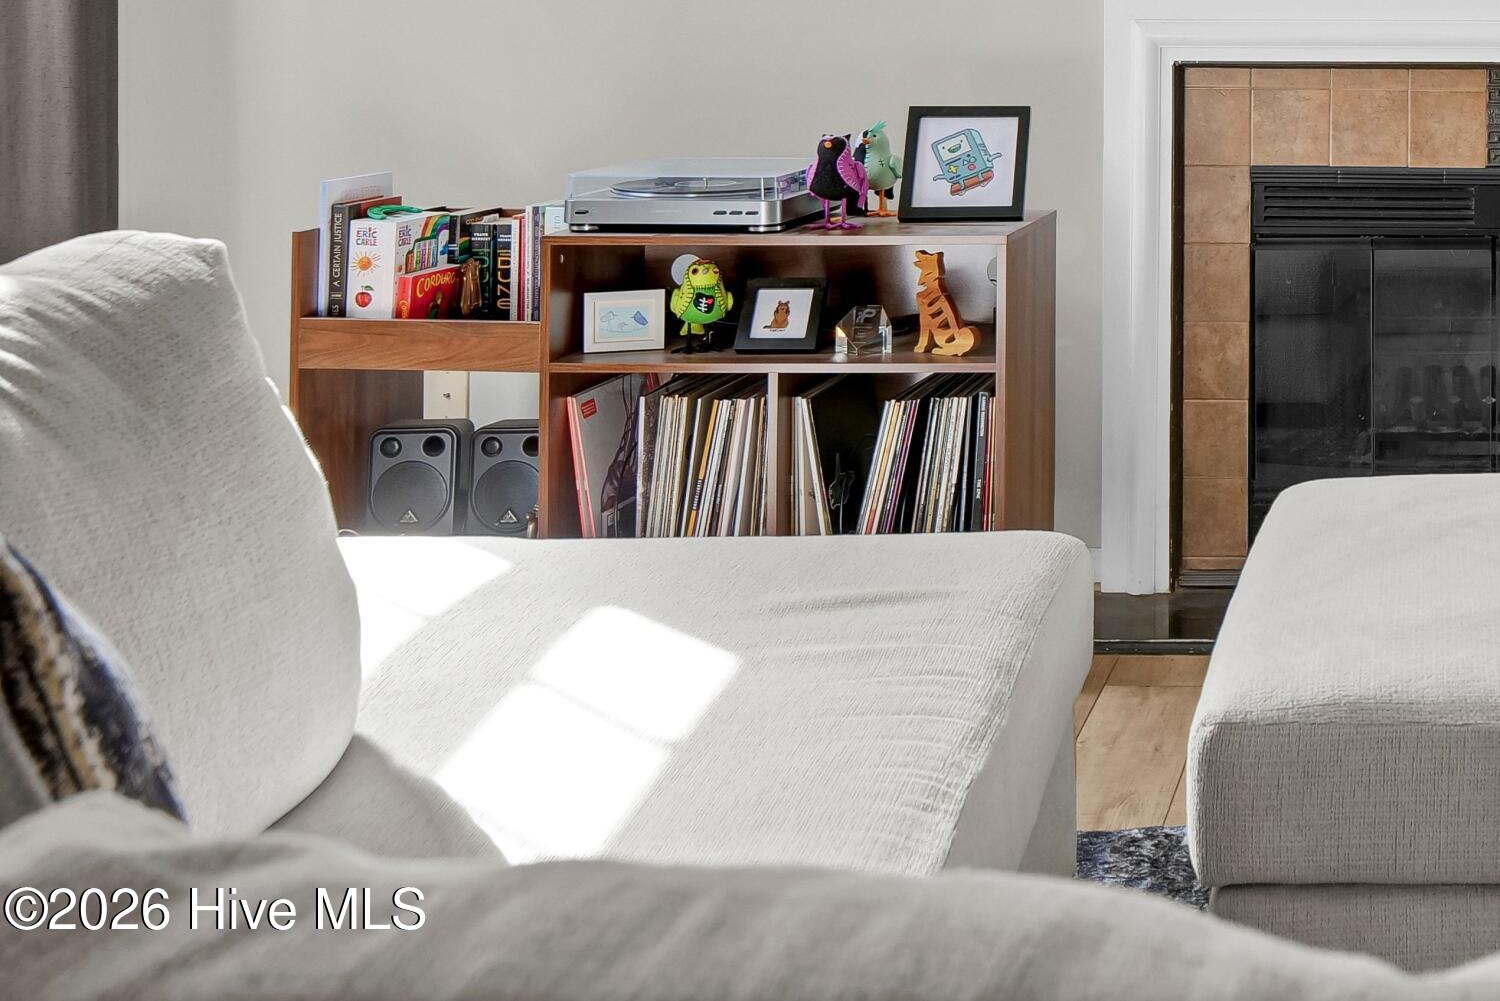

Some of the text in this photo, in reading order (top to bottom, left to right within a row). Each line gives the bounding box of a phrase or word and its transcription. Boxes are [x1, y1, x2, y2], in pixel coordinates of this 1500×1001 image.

[356, 228, 378, 238] ERIC
[355, 238, 378, 247] CARLE
[332, 213, 343, 287] A CERTAIN JUSTICE
